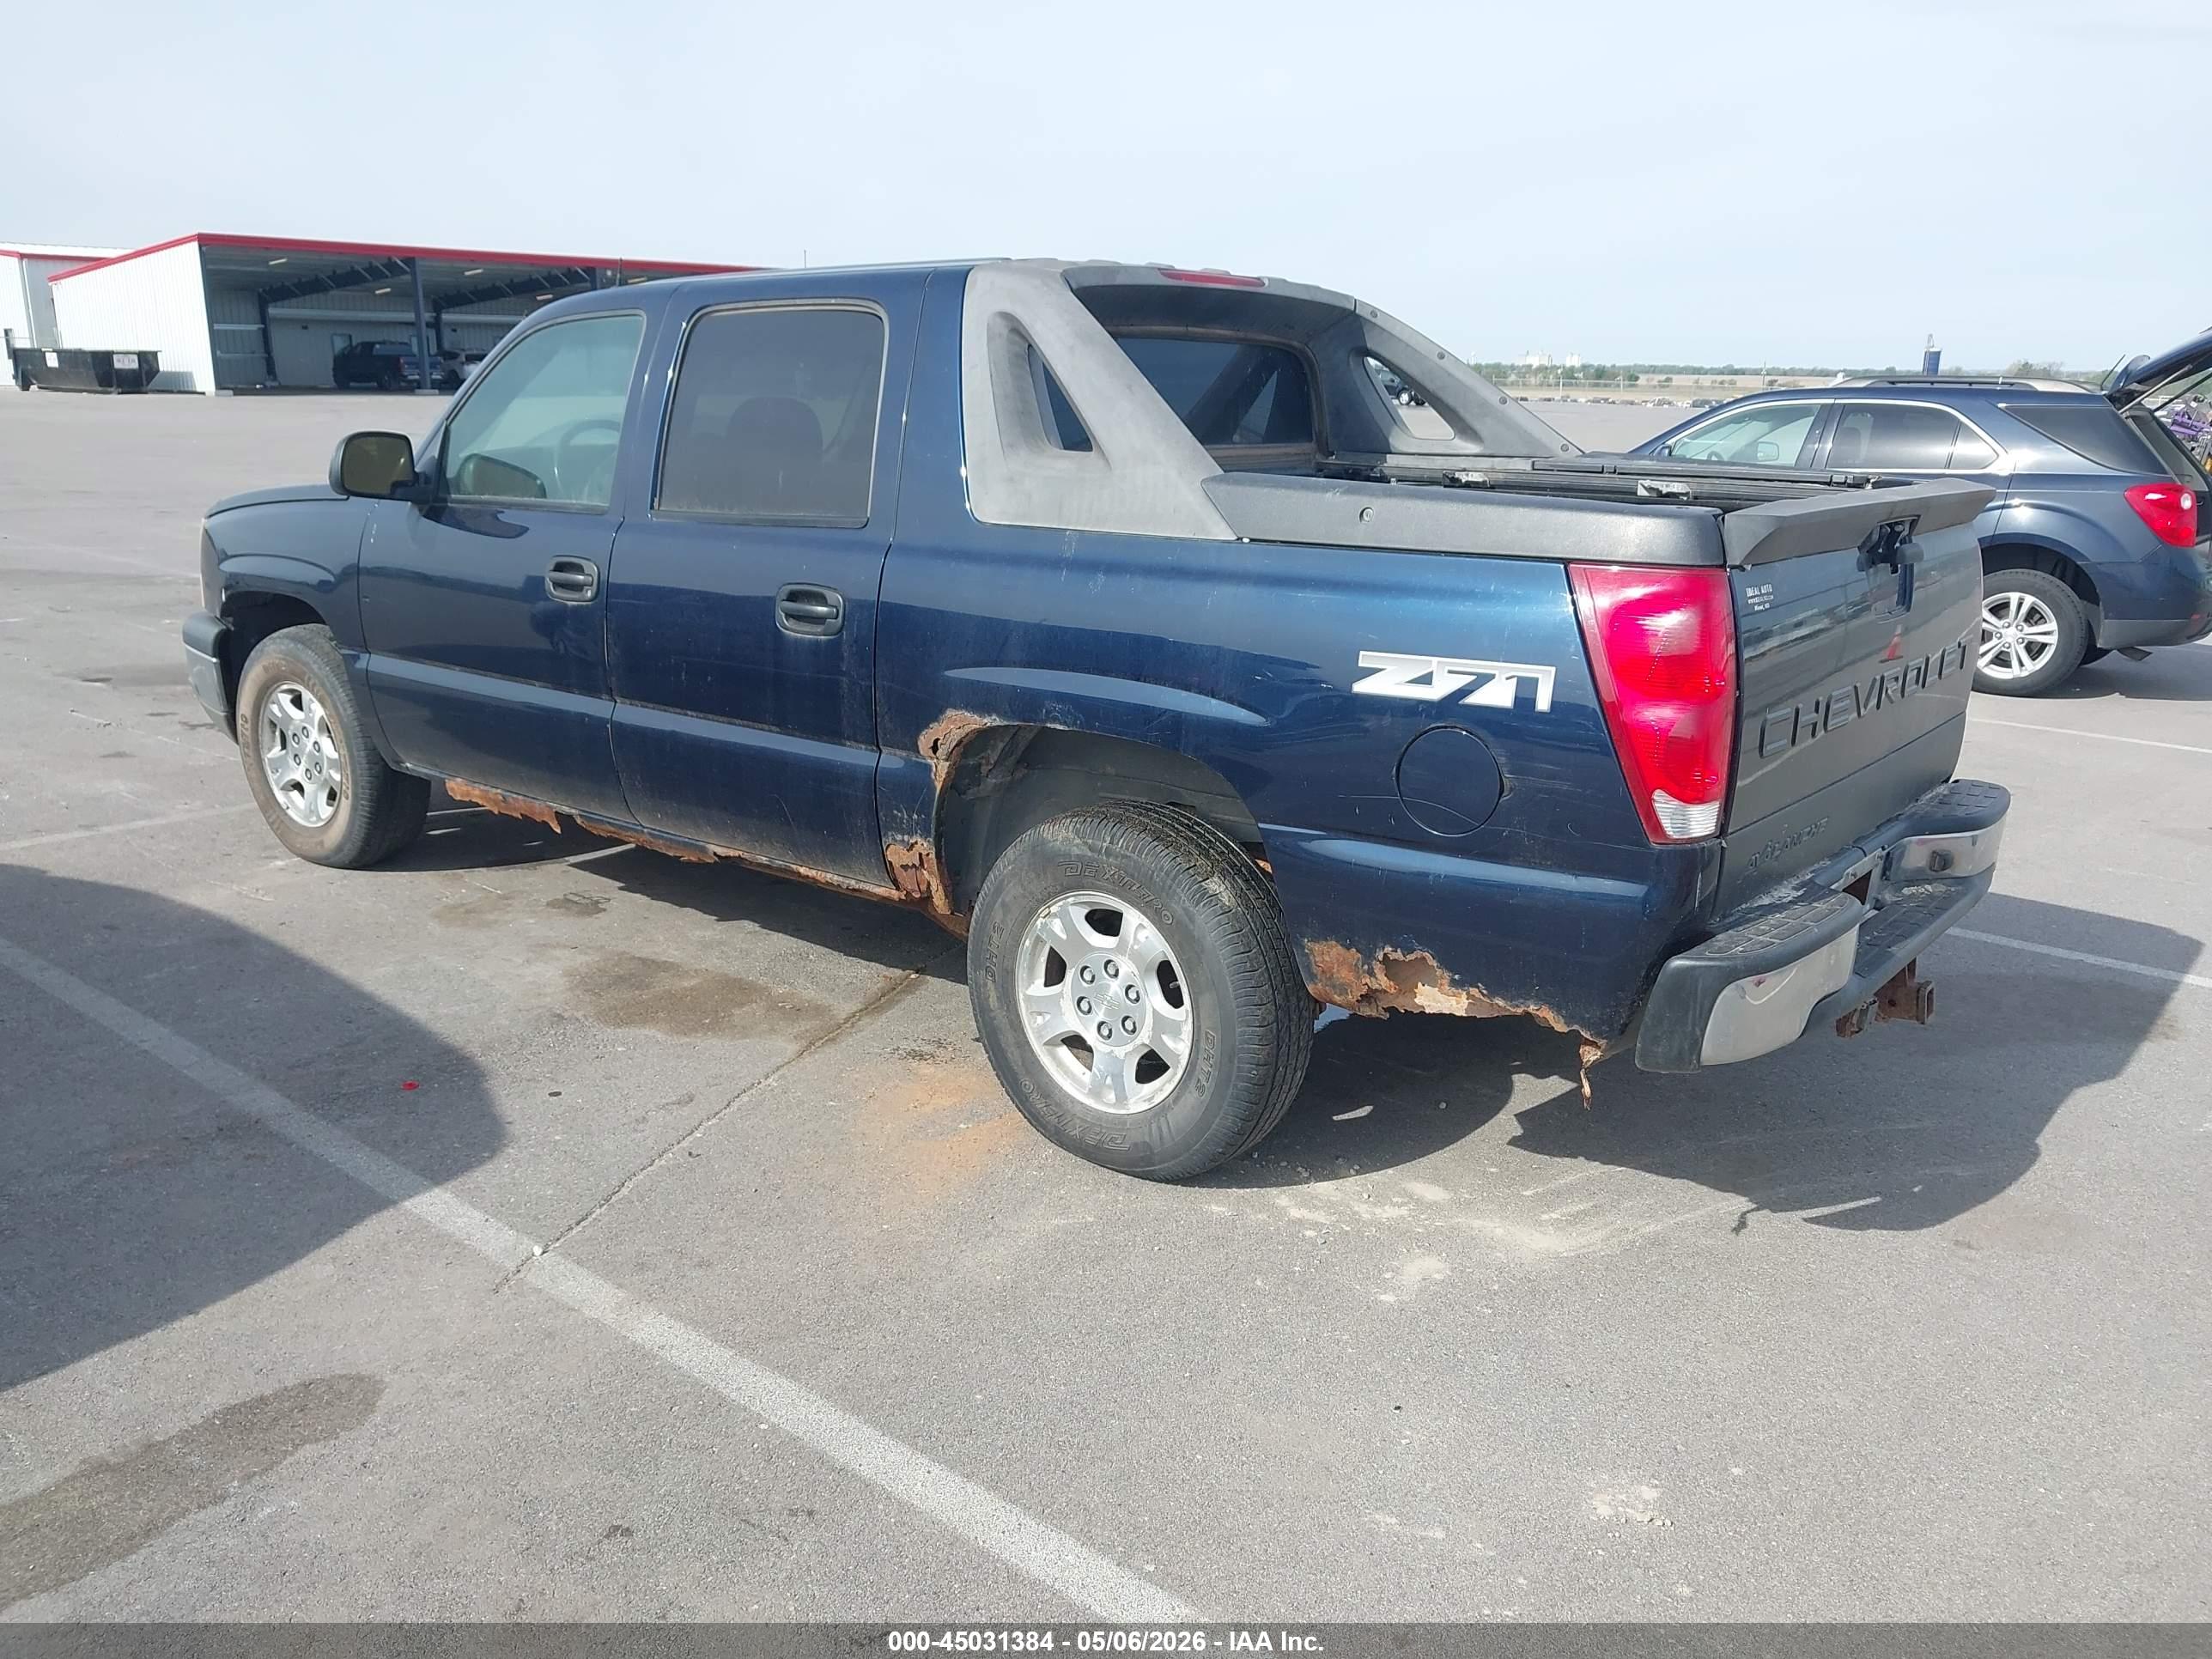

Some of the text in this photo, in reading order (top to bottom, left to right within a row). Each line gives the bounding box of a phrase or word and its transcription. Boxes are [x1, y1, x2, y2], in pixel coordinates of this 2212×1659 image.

[1746, 584, 1773, 597] IDEAL AUTO
[1352, 651, 1557, 714] Z71
[1759, 635, 1973, 759] CHEVROLET
[984, 921, 1006, 983] DHT2
[1194, 1030, 1217, 1098] DHT2
